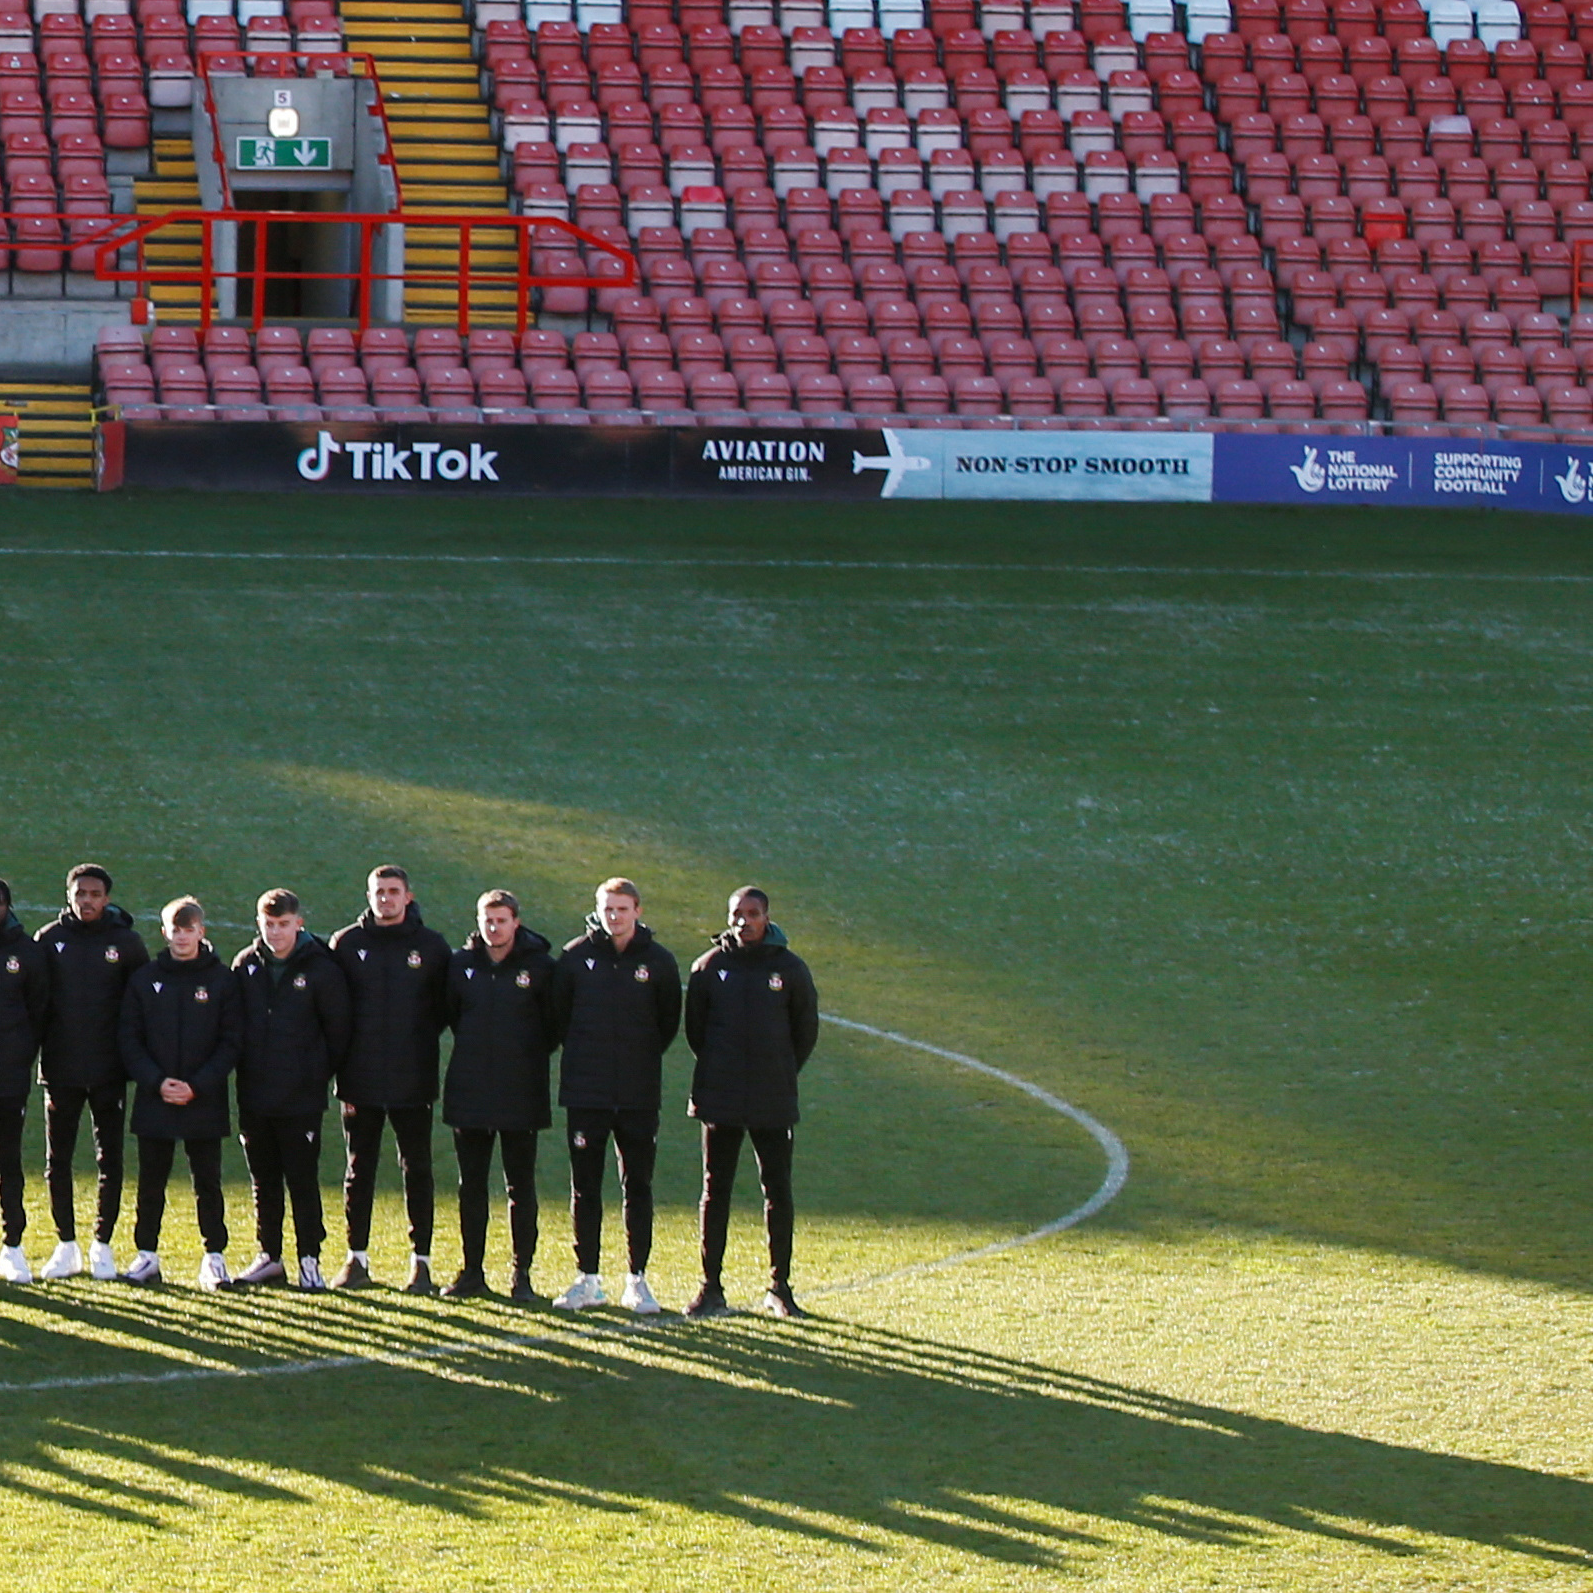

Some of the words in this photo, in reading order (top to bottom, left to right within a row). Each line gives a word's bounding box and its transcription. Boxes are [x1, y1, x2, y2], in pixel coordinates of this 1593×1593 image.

[278, 92, 287, 104] 5
[701, 439, 825, 462] AVIATION
[1327, 450, 1356, 464] THE
[344, 440, 500, 482] TikTok
[955, 455, 1078, 474] NON-STOP
[1084, 457, 1190, 476] SMOOTH
[1434, 452, 1522, 469] SUPPORTING
[718, 465, 783, 481] AMERICAN
[1327, 463, 1398, 479] NATIONAL
[1434, 466, 1520, 483] COMMUNITY
[1327, 477, 1391, 492] LOTTERY
[1434, 479, 1507, 495] FOOTBALL
